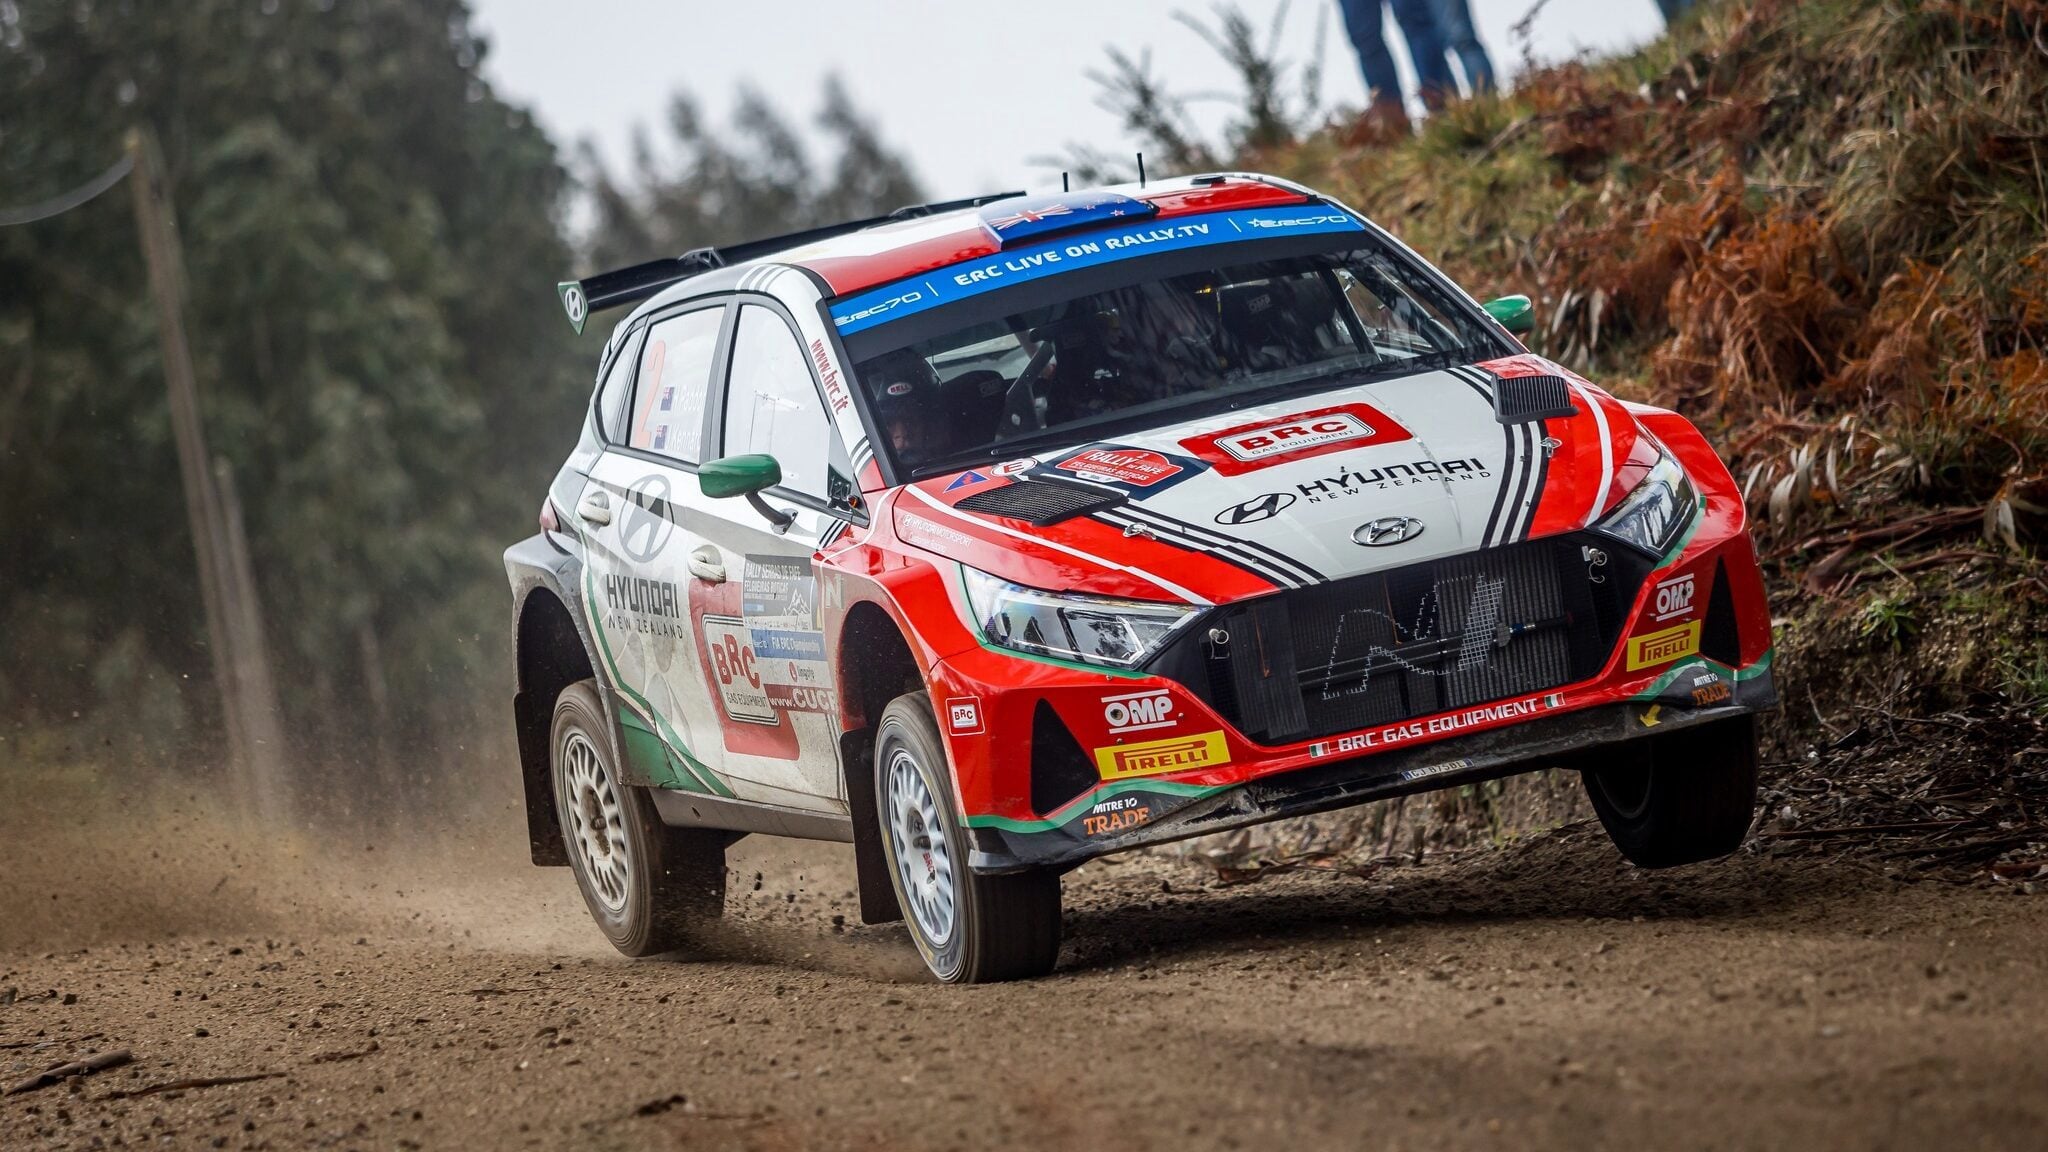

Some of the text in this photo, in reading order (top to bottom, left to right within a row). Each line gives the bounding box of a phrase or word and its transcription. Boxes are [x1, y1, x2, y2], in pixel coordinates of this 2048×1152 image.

[954, 223, 1210, 286] ERC LIVE ON RALLY.TV
[811, 338, 849, 415] www.brc.it
[890, 383, 911, 394] BELL
[634, 340, 667, 448] 2
[1235, 421, 1348, 451] BRC
[1251, 430, 1355, 455] GAS EQUIPMENT
[1003, 461, 1025, 474] E
[1085, 450, 1138, 467] RALLY
[1296, 457, 1486, 496] HYUNDAI
[1309, 471, 1491, 504] NEW ZEALAND
[606, 573, 680, 619] HYUNDAI
[1656, 580, 1695, 614] OMP
[608, 615, 683, 640] NEW ZEALAND
[711, 633, 761, 690] BRC
[1638, 628, 1691, 663] PIRELLI
[954, 708, 974, 721] BRC
[1104, 695, 1174, 728] OMP
[1337, 698, 1538, 753] BRC GAS EQUIPMENT
[1113, 739, 1208, 773] PIRELLI
[1083, 807, 1150, 836] TRADE
[1092, 797, 1138, 815] MITRE 10
